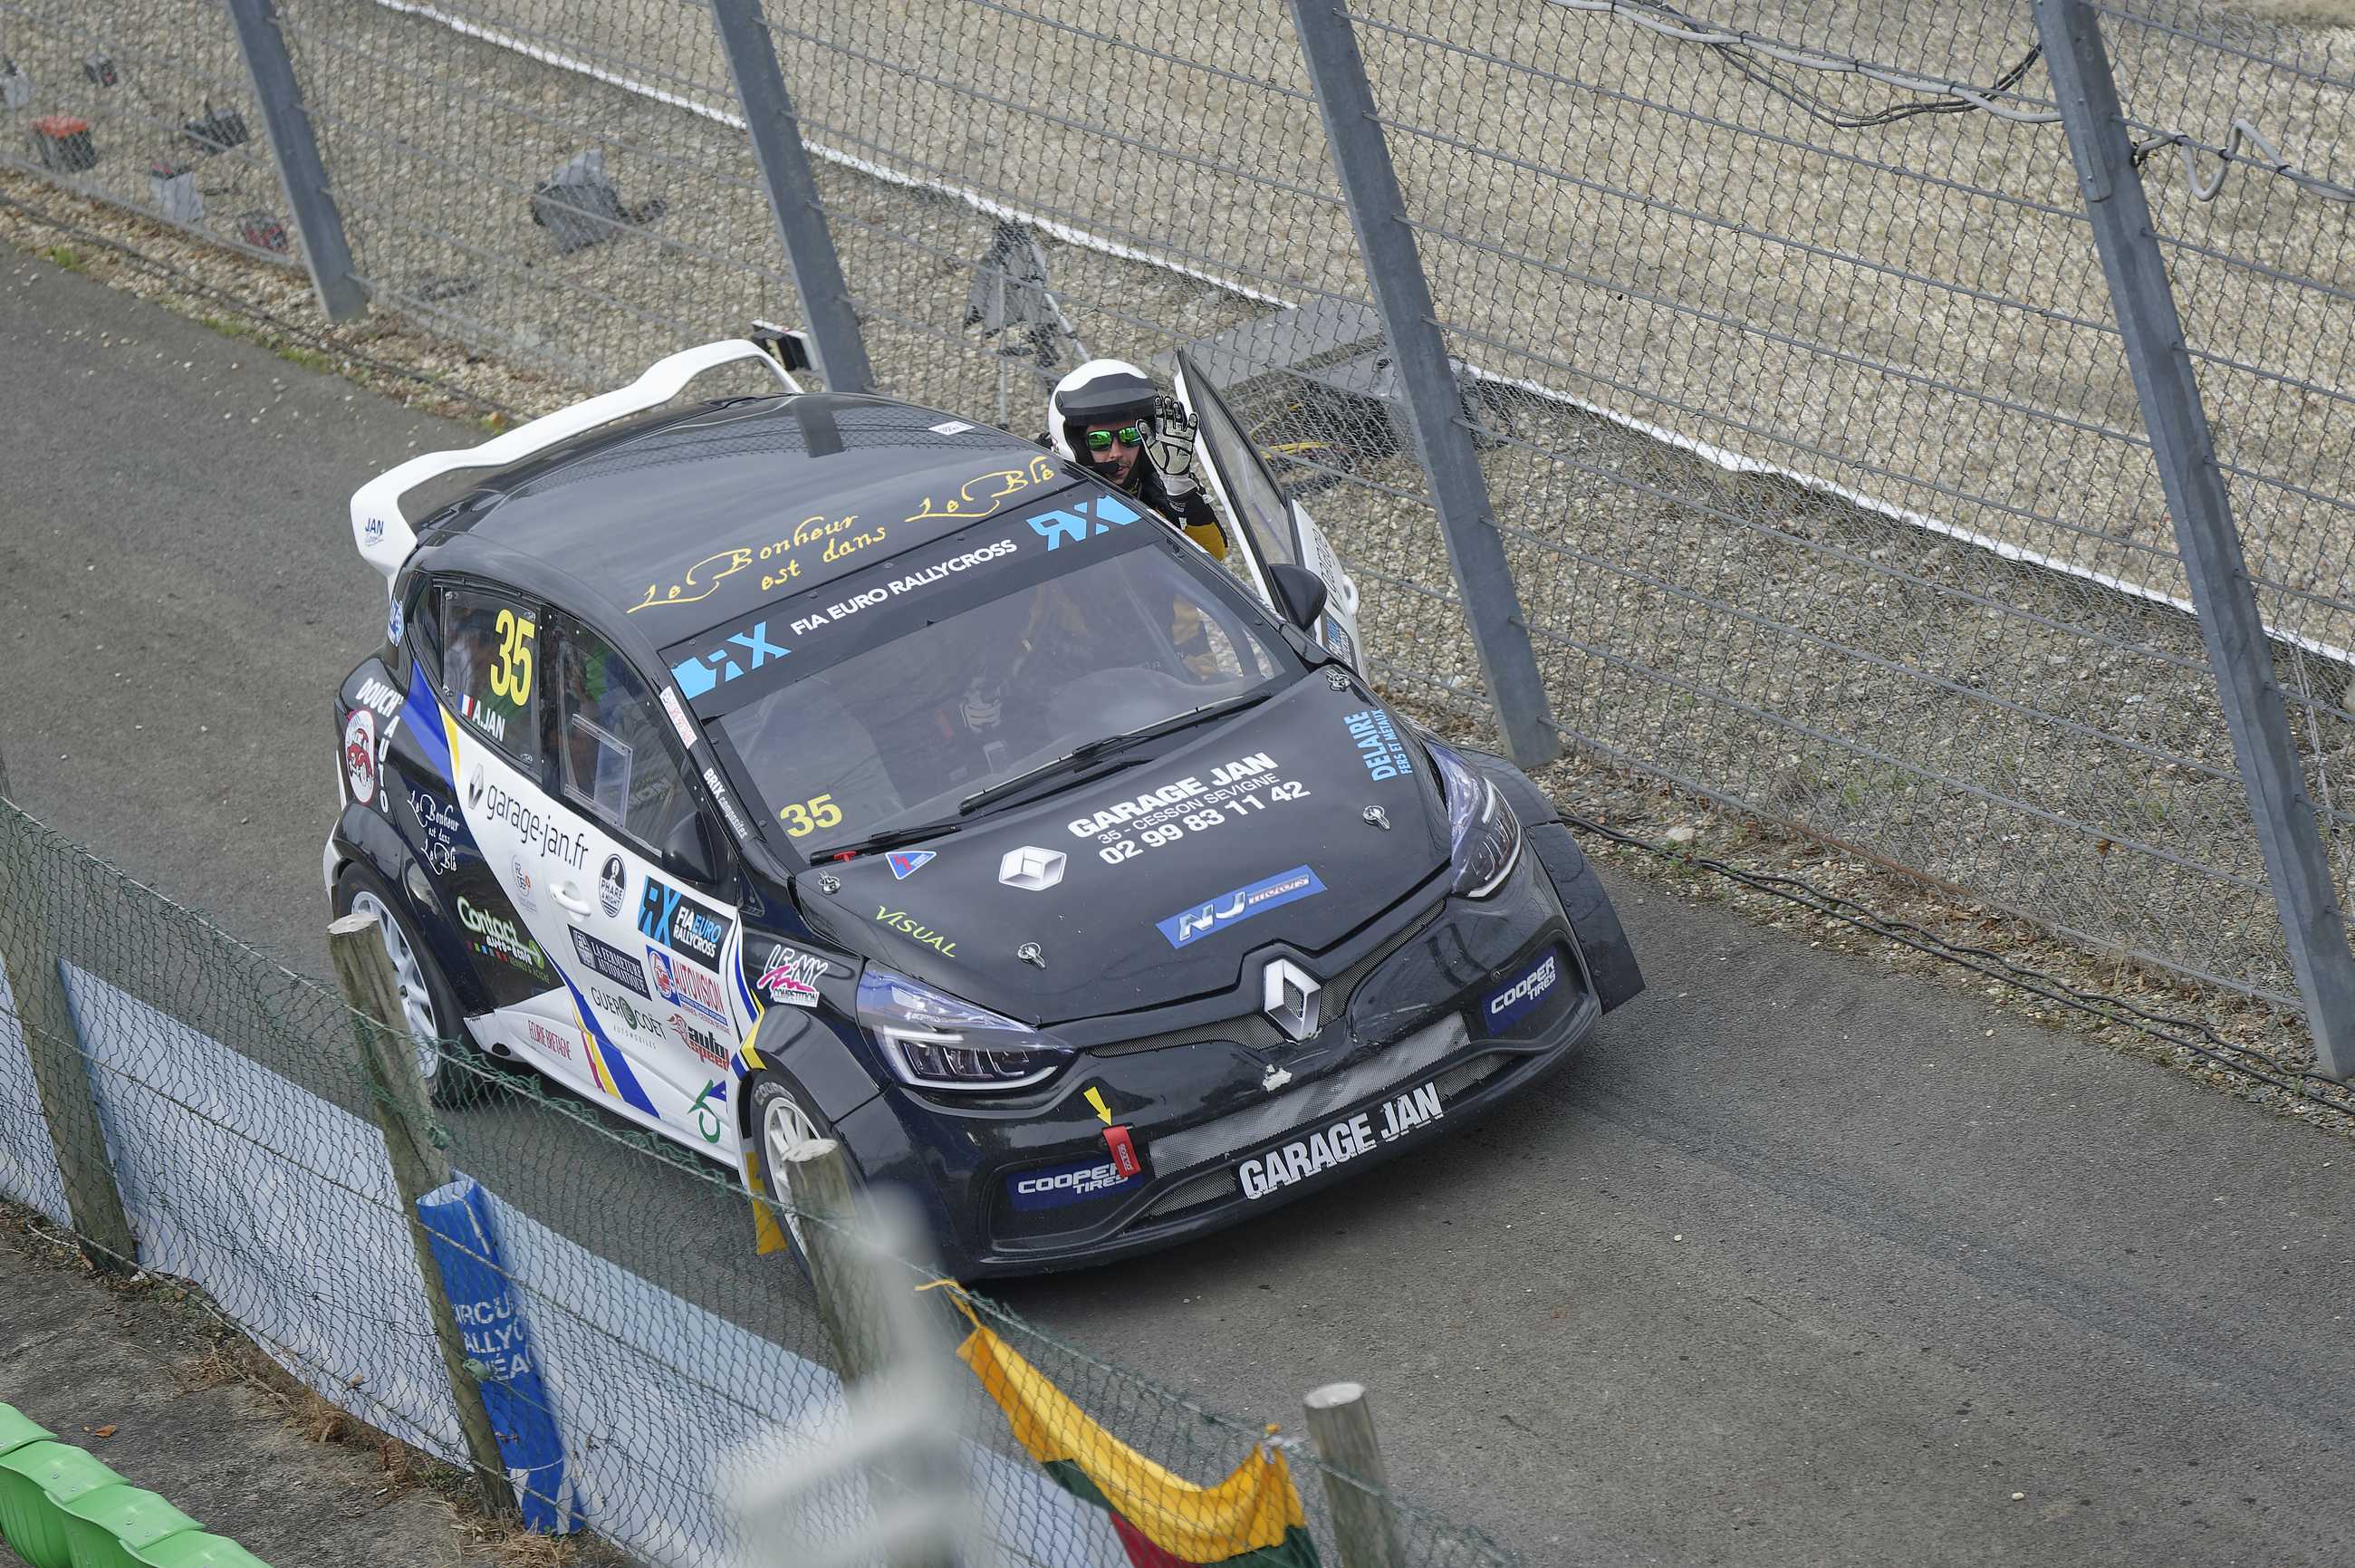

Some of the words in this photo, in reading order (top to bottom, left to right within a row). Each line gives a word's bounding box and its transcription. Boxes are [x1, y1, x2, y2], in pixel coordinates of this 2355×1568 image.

[364, 517, 384, 535] JAN
[686, 516, 859, 585] Bonheur
[760, 559, 802, 591] est
[822, 525, 886, 563] dans
[790, 613, 830, 635] FIA
[826, 588, 889, 620] EURO
[887, 539, 1018, 595] RALLYCROSS
[490, 609, 535, 707] 35
[472, 700, 505, 742] A.JAN
[1343, 711, 1397, 781] DELAIRE
[1370, 708, 1398, 741] METAUX
[378, 715, 400, 813] AUTO
[1388, 743, 1403, 753] ET
[1393, 753, 1413, 774] FERS
[703, 767, 725, 800] BRIX
[718, 795, 748, 841] composites
[780, 794, 842, 838] 35
[1067, 776, 1209, 838] GARAGE
[1210, 752, 1279, 786] JAN
[1097, 829, 1122, 844] 35
[1132, 799, 1206, 831] CESSON
[1203, 773, 1282, 803] SEVIGNE
[486, 783, 589, 871] garage-jan.fr
[1099, 839, 1144, 865] 02
[1140, 823, 1184, 848] 99
[1182, 808, 1226, 832] 83
[1224, 794, 1266, 816] 11
[1270, 781, 1312, 803] 42
[601, 879, 623, 901] PHARE
[457, 896, 520, 946] Contact
[673, 924, 716, 958] RALLYCROSS
[675, 906, 695, 931] FIA
[692, 914, 722, 943] EURO
[1179, 890, 1245, 942] NJ
[591, 942, 603, 958] LA
[601, 947, 643, 979] FERMETURE
[598, 957, 647, 993] AUTOMATIQUE
[1491, 956, 1555, 1014] COOPER
[1527, 970, 1556, 1000] TIRES
[672, 958, 726, 1015] AUTOVISION
[687, 1025, 726, 1060] auto
[1239, 1112, 1377, 1200] GARAGE
[1380, 1082, 1444, 1142] JAN
[1072, 1174, 1129, 1195] TIRES
